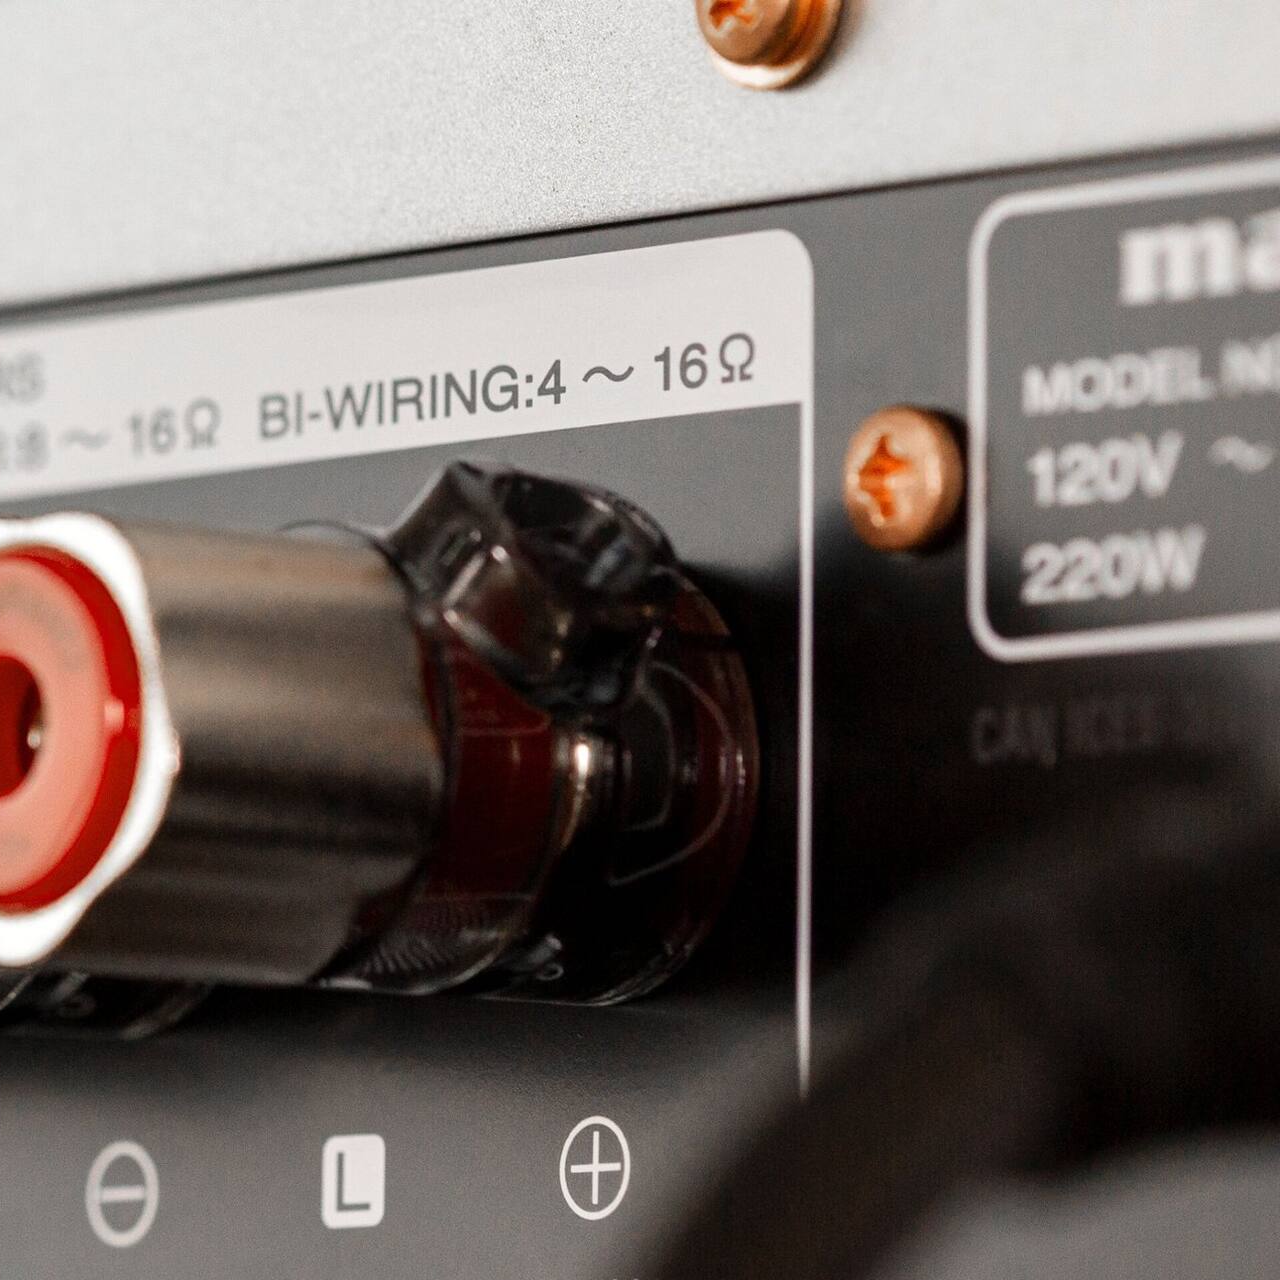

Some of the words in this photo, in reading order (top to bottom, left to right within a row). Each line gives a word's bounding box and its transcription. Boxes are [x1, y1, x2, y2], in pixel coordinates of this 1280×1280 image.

[257, 358, 567, 439] BI-WIRING:4
[1022, 345, 1214, 416] MODEL
[1220, 332, 1280, 398] N
[1028, 428, 1186, 507] 120V
[1020, 523, 1207, 606] 220W
